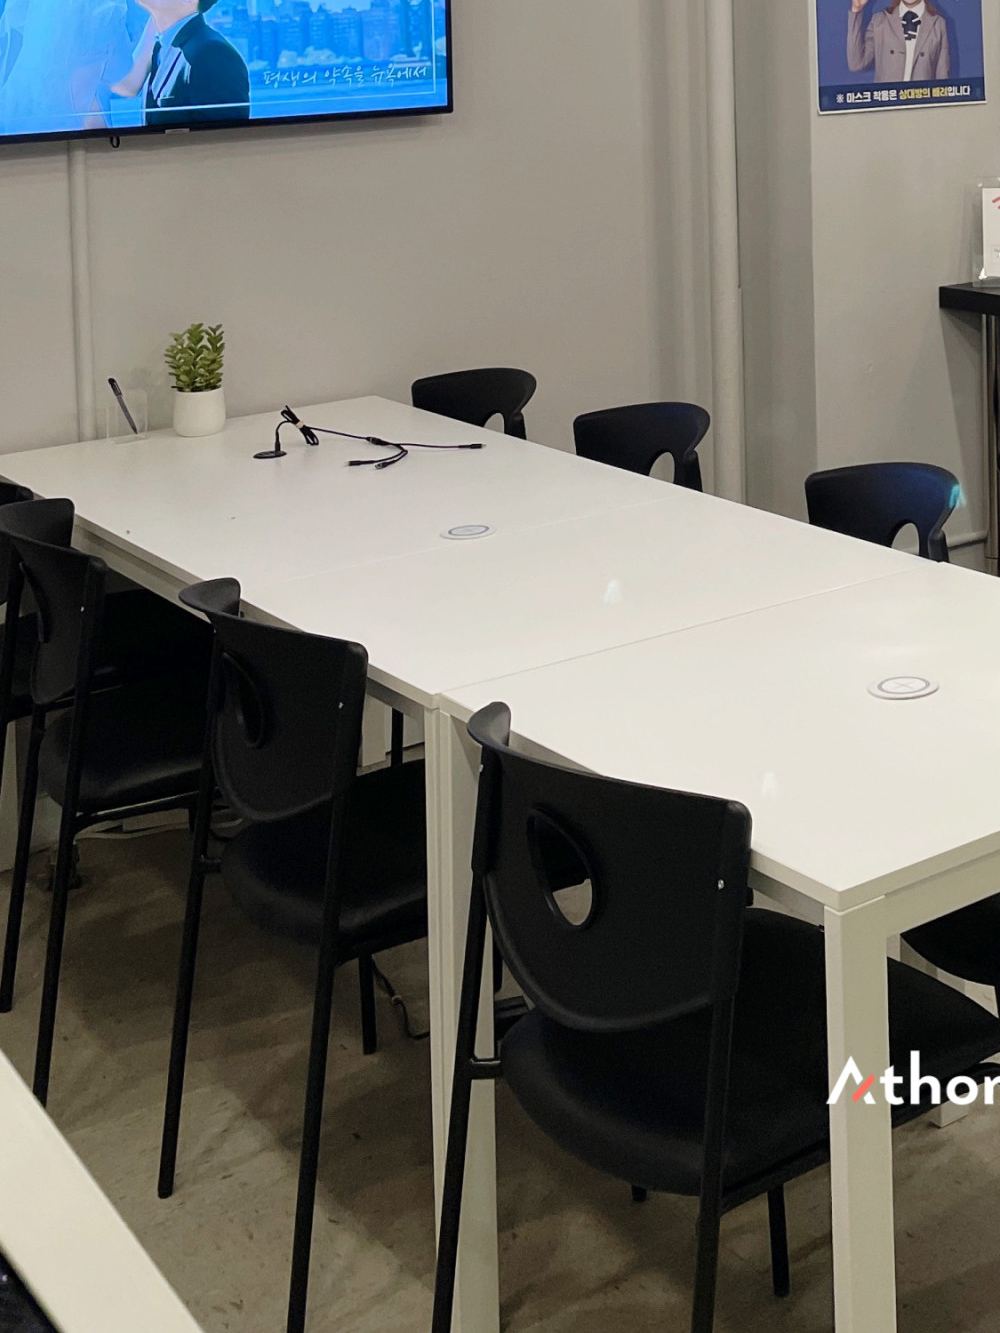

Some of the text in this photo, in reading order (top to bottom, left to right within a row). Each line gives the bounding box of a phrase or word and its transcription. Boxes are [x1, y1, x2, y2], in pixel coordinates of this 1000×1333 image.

[263, 63, 427, 89] 평생의 약속을 뉴욕에서
[846, 91, 872, 103] 마스크
[899, 87, 931, 100] 상대방의
